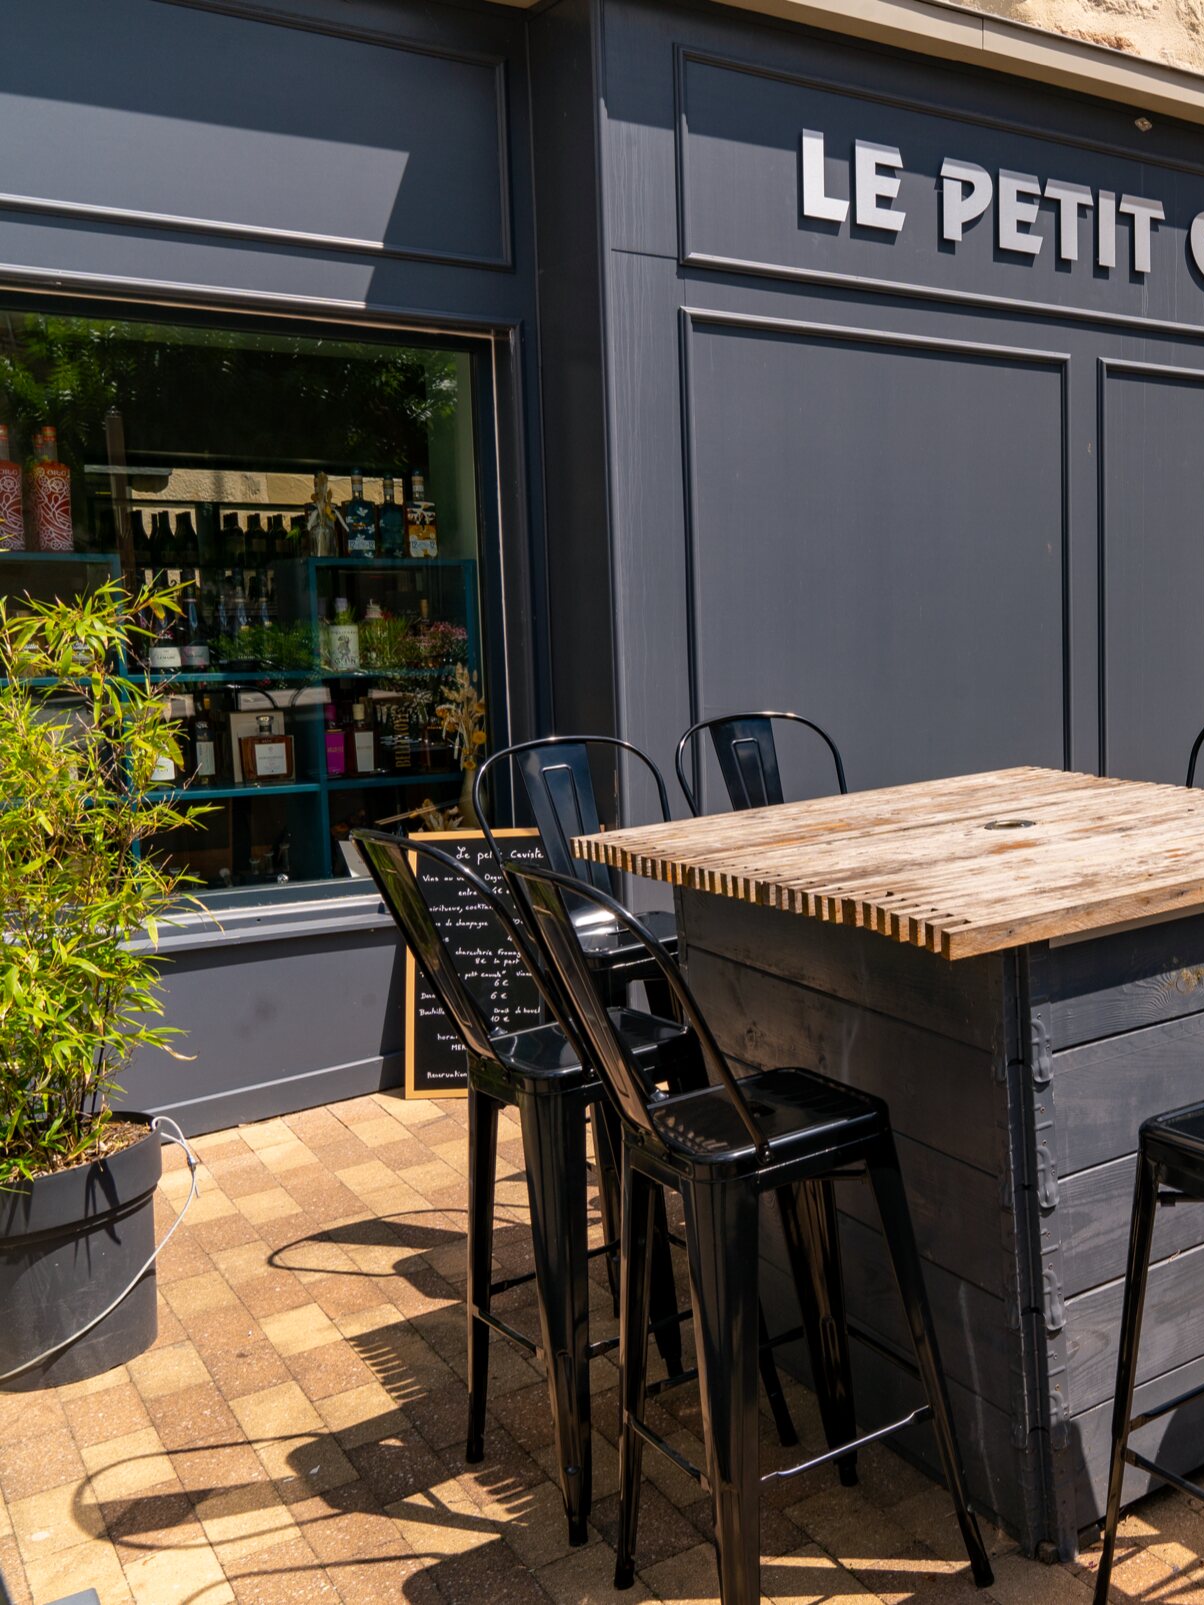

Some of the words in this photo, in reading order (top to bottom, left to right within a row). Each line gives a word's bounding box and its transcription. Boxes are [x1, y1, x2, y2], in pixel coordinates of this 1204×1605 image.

[802, 128, 907, 232] LE
[938, 156, 1166, 274] PETIT
[456, 846, 470, 860] Le
[494, 979, 500, 987] 6
[490, 991, 498, 1000] 6
[490, 1015, 500, 1023] 10
